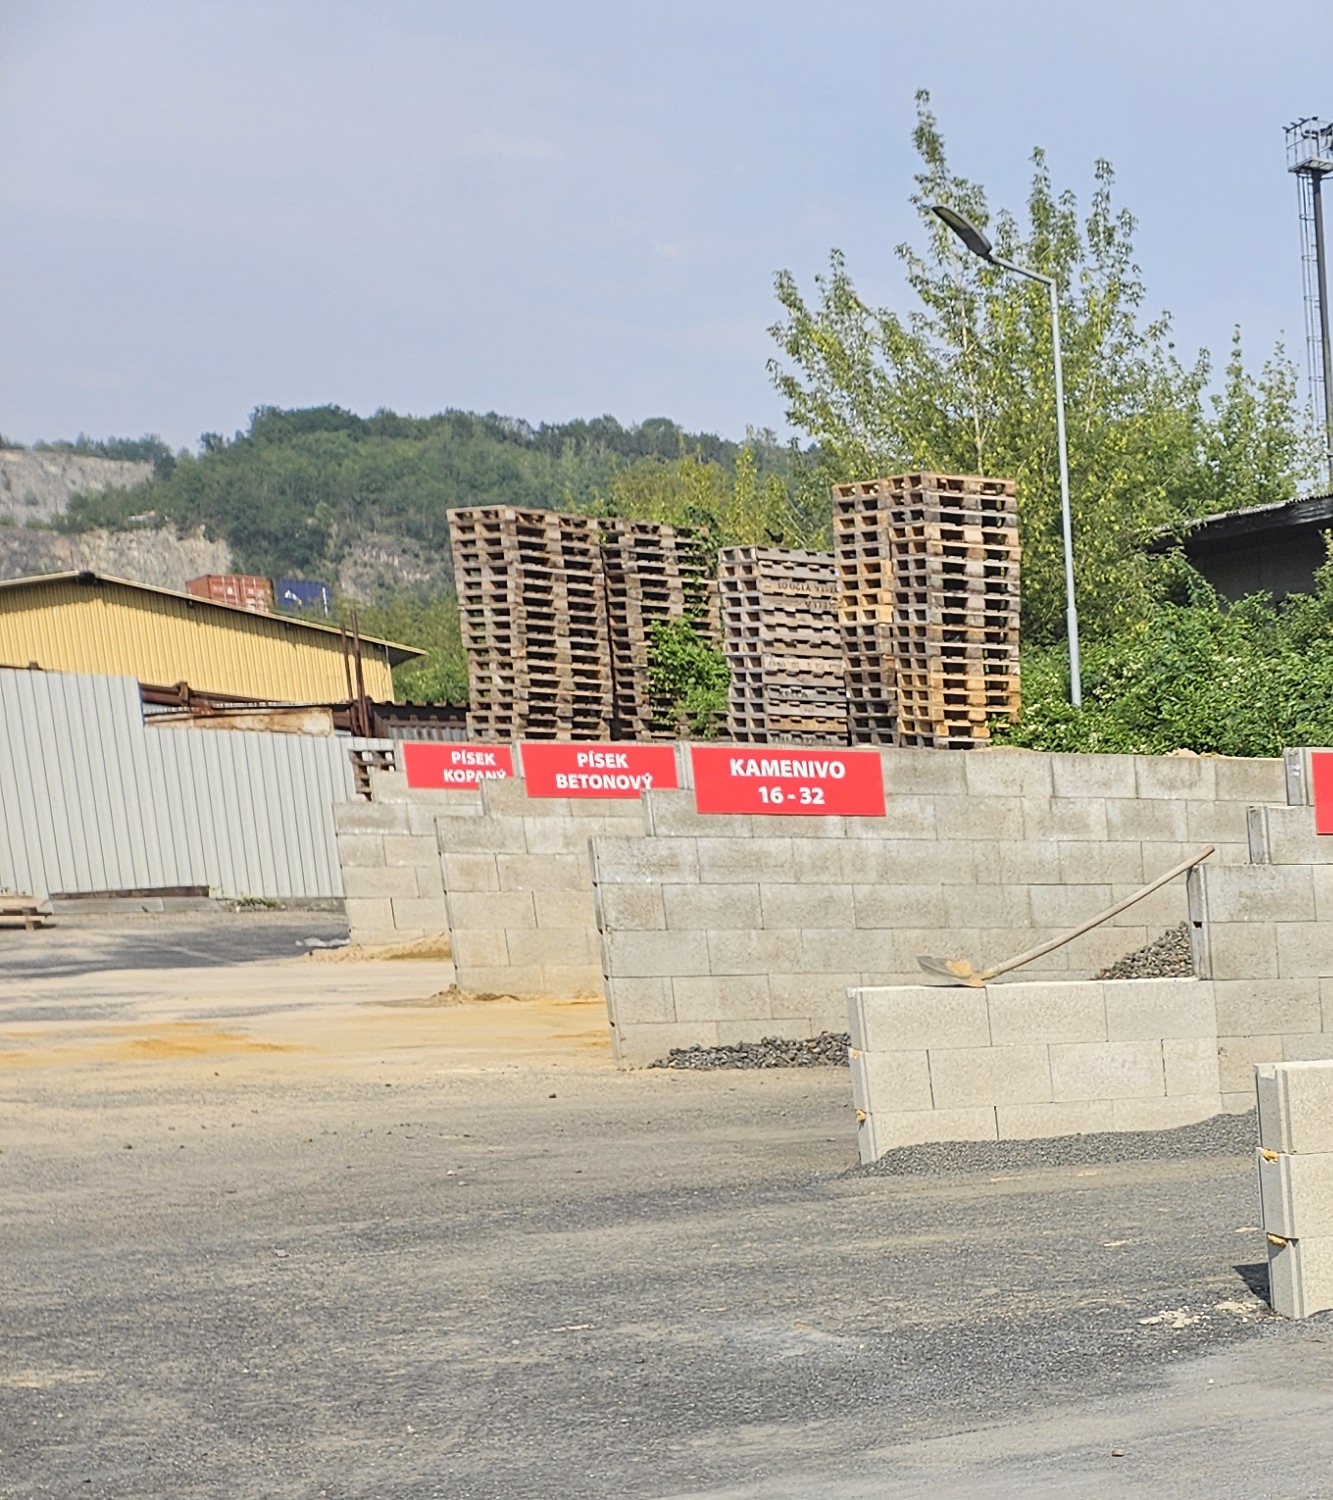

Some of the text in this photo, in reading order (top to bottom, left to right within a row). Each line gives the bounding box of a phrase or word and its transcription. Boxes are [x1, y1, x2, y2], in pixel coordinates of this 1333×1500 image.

[451, 749, 497, 766] PÍSEK
[576, 750, 629, 769] PÍSEK
[443, 768, 507, 783] KOPANÝ
[729, 758, 846, 779] KAMENIVO
[555, 772, 654, 791] BETONOVÝ
[758, 786, 785, 804] 16
[799, 787, 826, 805] 32
